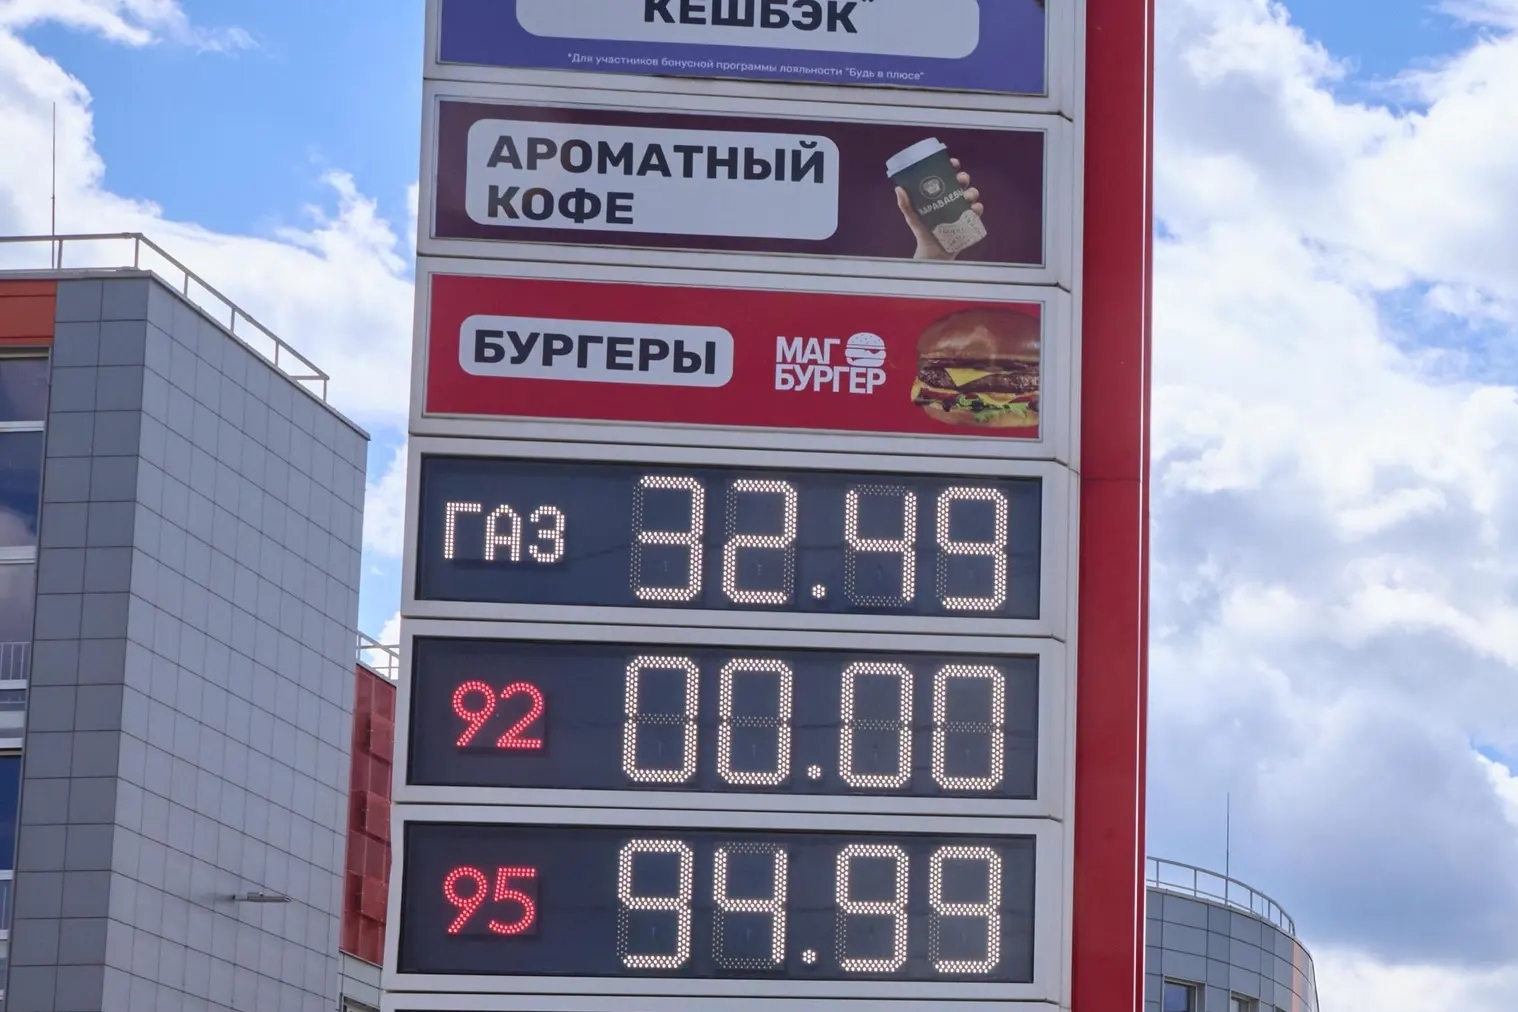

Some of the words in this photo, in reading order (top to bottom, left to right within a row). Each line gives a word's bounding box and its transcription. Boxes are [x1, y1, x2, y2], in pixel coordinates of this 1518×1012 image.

[644, 0, 874, 33] КЕШБЭК
[595, 56, 659, 66] участников
[661, 57, 714, 70] бонусной
[716, 61, 777, 72] программы
[780, 64, 843, 76] лояльности
[487, 135, 826, 184] АРОМАТНЫЙ
[487, 184, 635, 226] КОФЕ
[473, 329, 716, 375] БУРГЕРЫ
[776, 336, 840, 366] МАГ
[774, 363, 887, 395] БУРГЕР
[444, 502, 565, 563] ГАЗ
[632, 474, 1008, 611] 32.49
[452, 680, 544, 749] 92
[622, 655, 1006, 791] 00.00
[443, 866, 536, 934] 95
[617, 838, 1002, 974] 94.99
